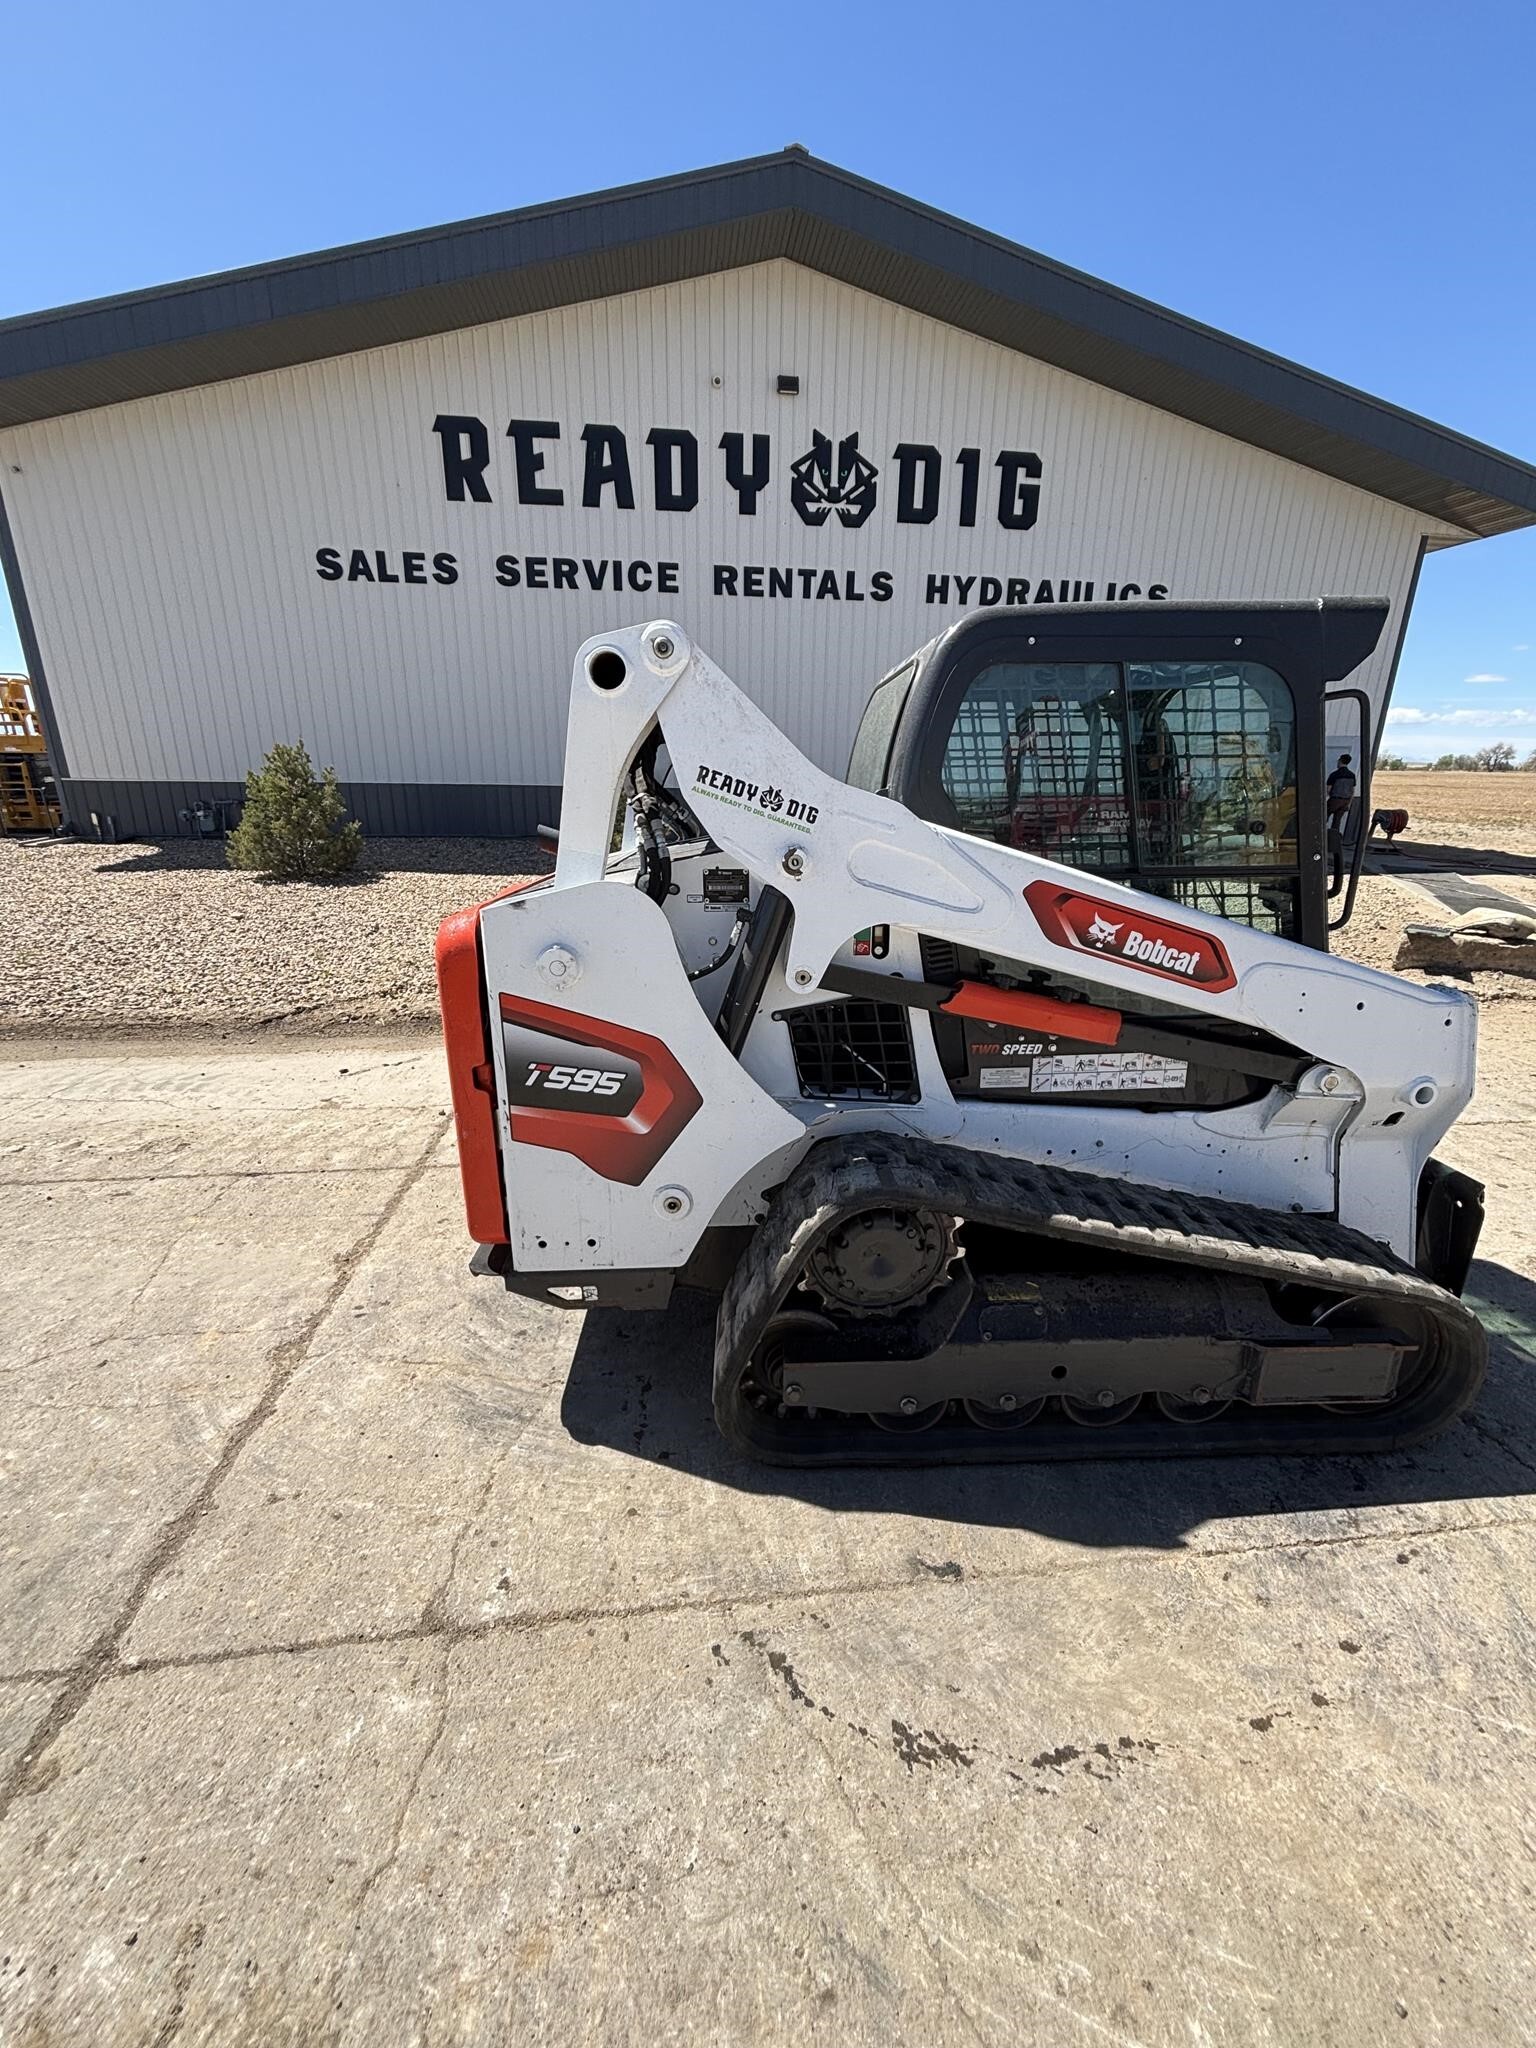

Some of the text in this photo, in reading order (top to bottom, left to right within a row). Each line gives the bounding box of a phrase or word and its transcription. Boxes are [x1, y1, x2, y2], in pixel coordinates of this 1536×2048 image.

[432, 414, 1043, 531] READY DIG
[316, 548, 459, 585] SALES
[495, 554, 680, 594] SERVICE
[713, 564, 894, 602] RENTALS
[691, 785, 719, 800] ALWAYS
[719, 795, 742, 808] READY
[743, 803, 753, 812] TO
[696, 765, 819, 825] READY DIG
[1122, 930, 1201, 976] Bobcat
[1002, 1043, 1043, 1055] SPEED
[525, 1063, 627, 1095] T595
